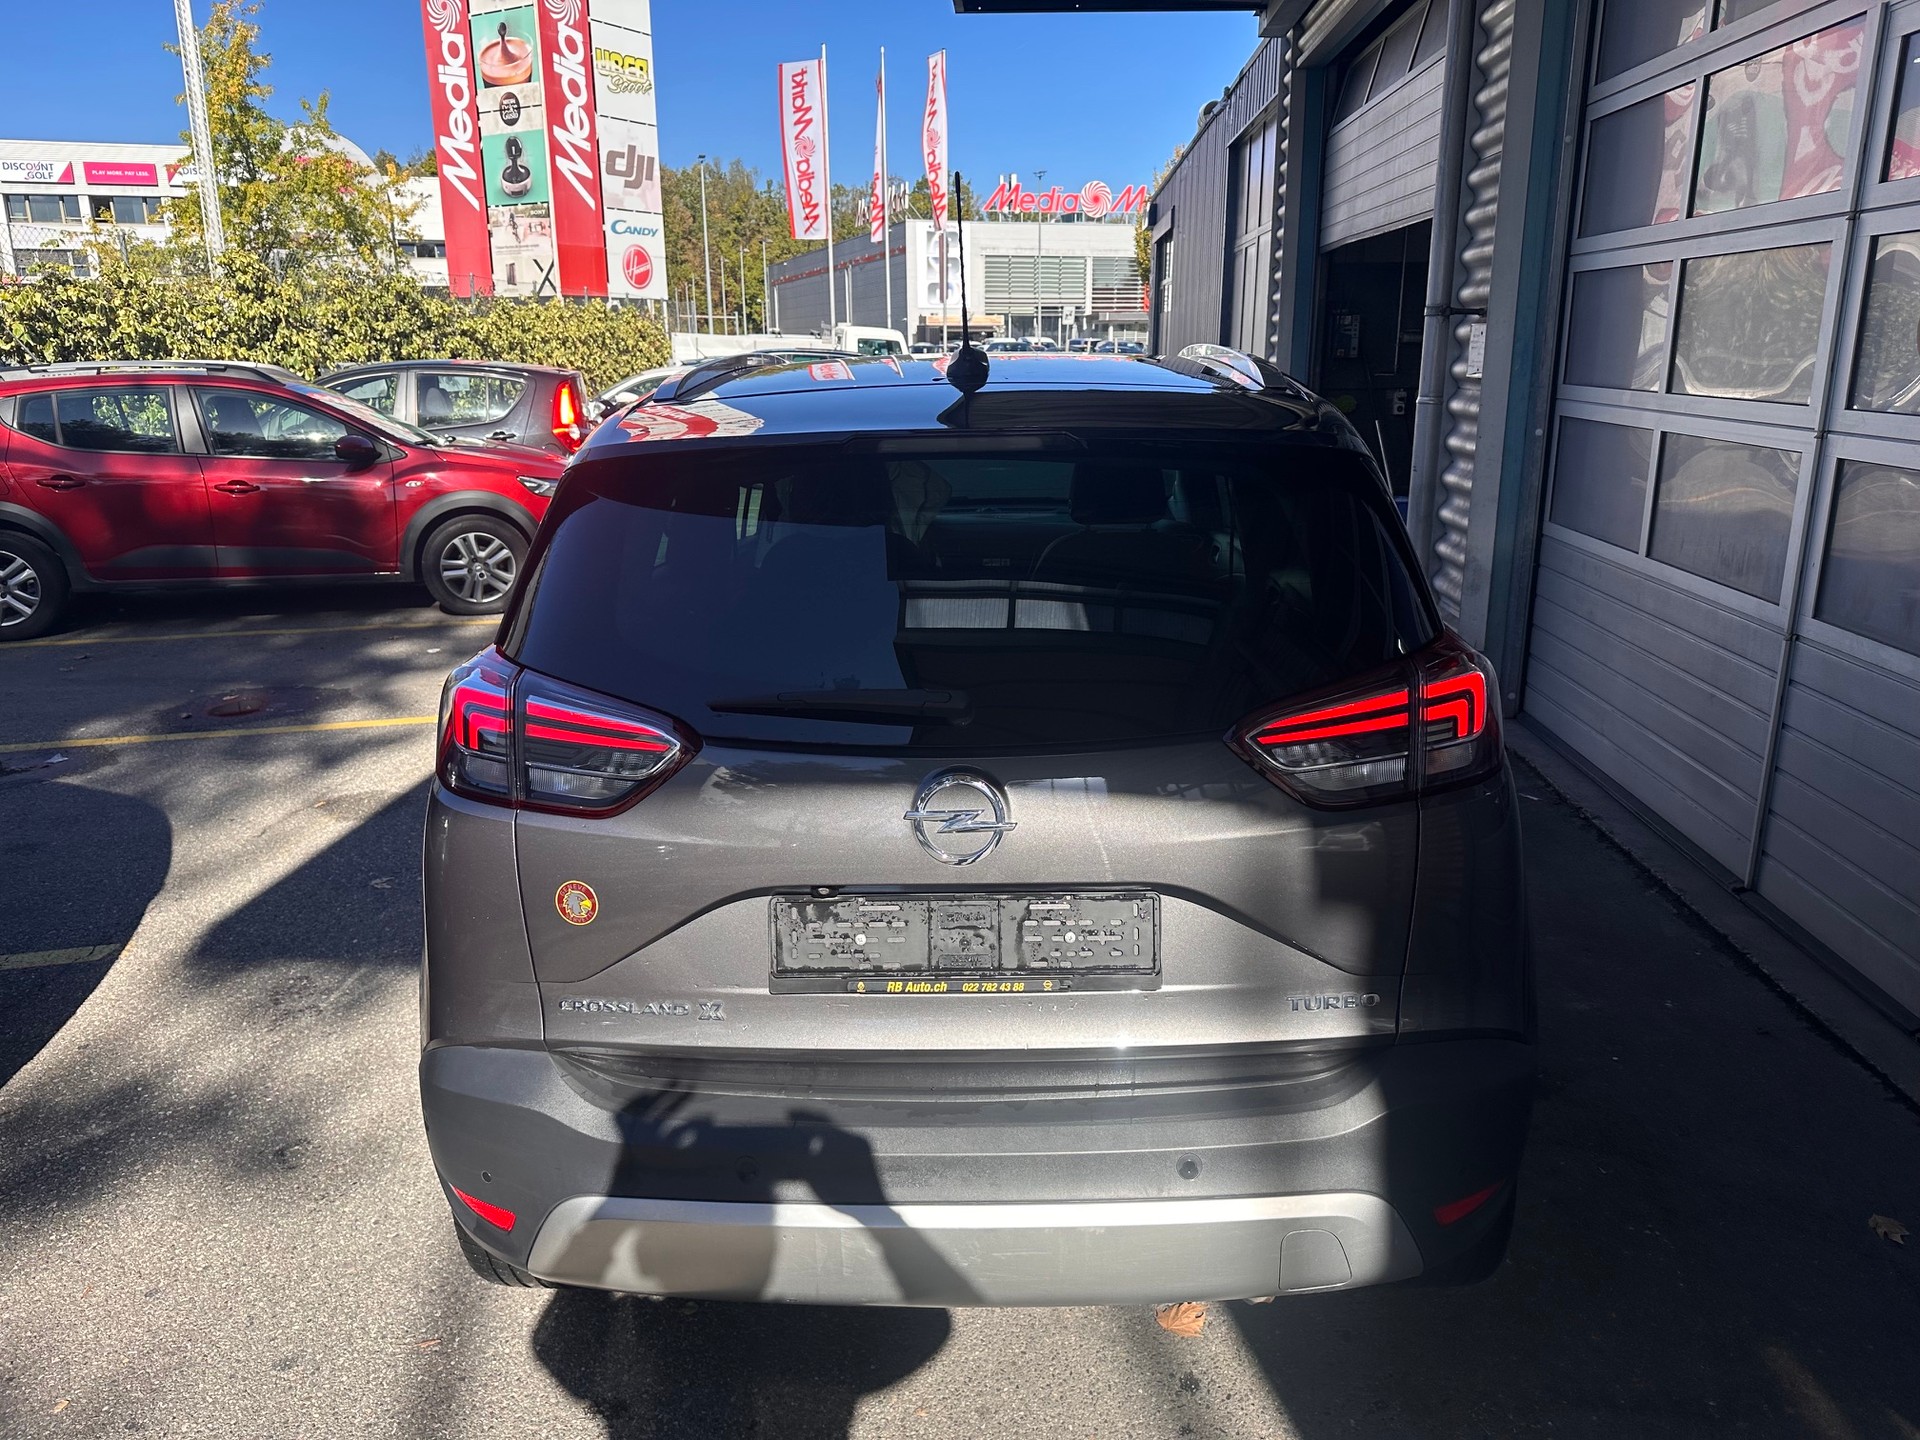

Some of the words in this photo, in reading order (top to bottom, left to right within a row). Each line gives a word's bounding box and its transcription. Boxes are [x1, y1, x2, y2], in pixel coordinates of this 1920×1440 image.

[437, 31, 481, 212] Media
[552, 22, 597, 212] Media
[2, 161, 54, 171] DISCOUNT
[27, 171, 54, 180] GOLF
[983, 183, 1081, 213] Media
[886, 981, 902, 993] RB
[905, 981, 947, 993] Auto.ch
[962, 982, 978, 992] 022
[981, 982, 997, 992] 782
[999, 982, 1010, 992] 43
[1013, 982, 1024, 992] 88
[559, 999, 691, 1016] CROSSLAND
[1286, 992, 1381, 1012] TURBO
